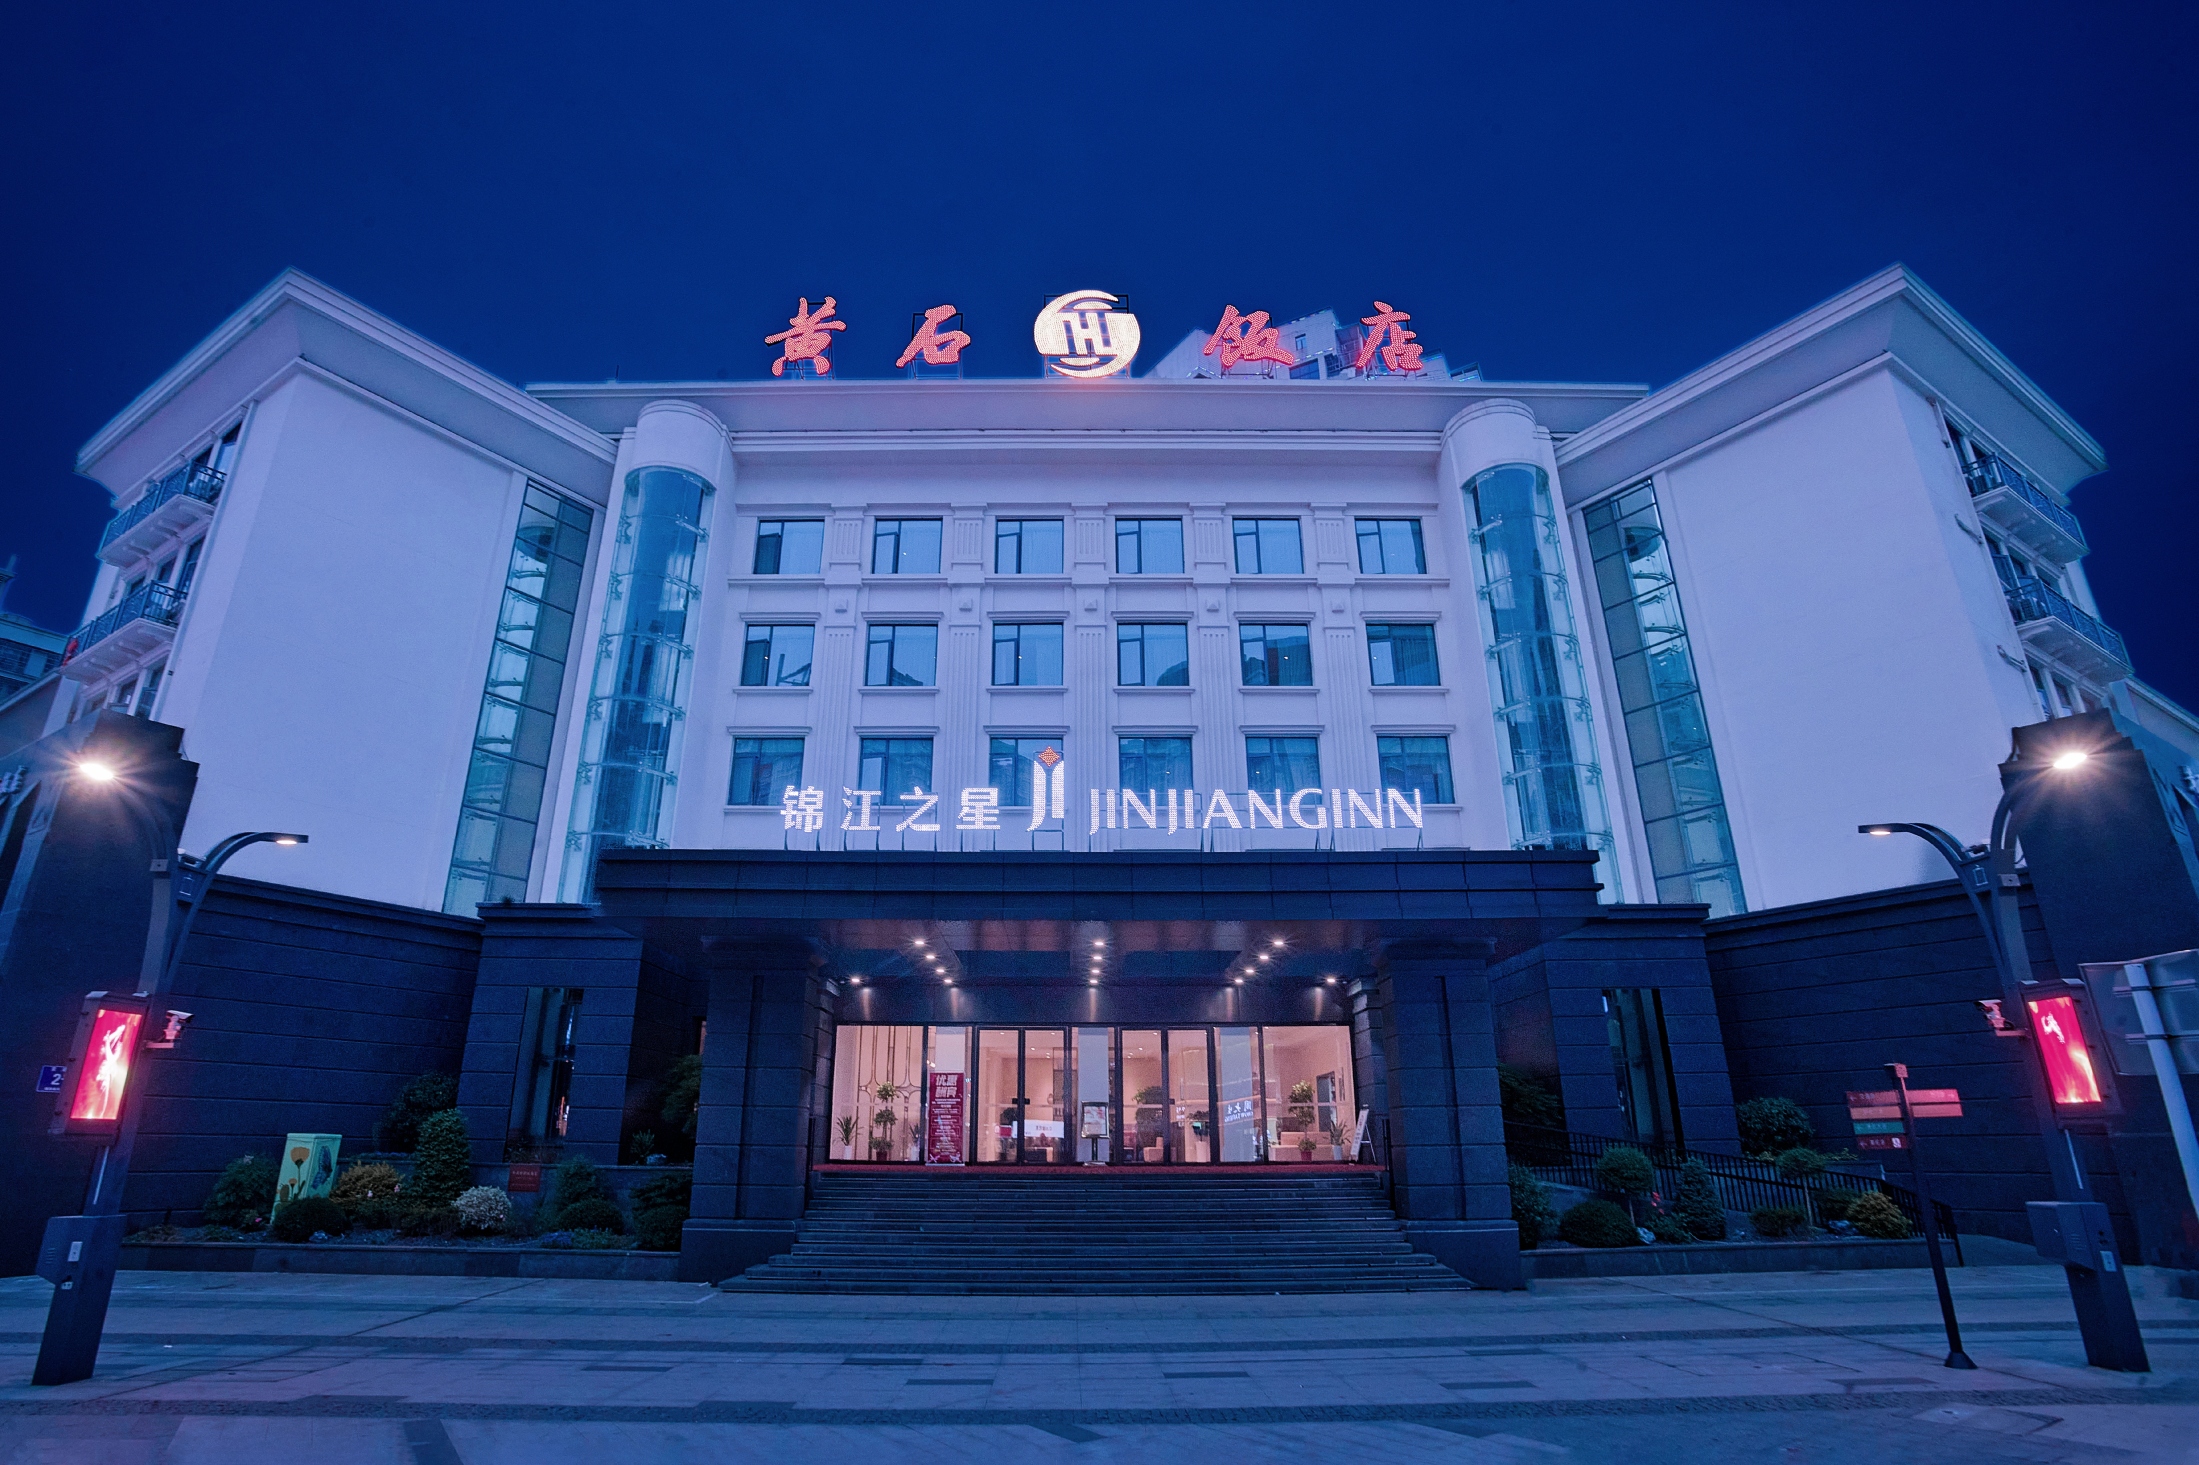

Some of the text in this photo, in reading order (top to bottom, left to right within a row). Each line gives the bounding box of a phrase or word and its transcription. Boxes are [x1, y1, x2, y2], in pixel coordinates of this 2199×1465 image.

[780, 785, 1000, 832] 锦江之星
[1089, 788, 1424, 836] JINJIANGINN
